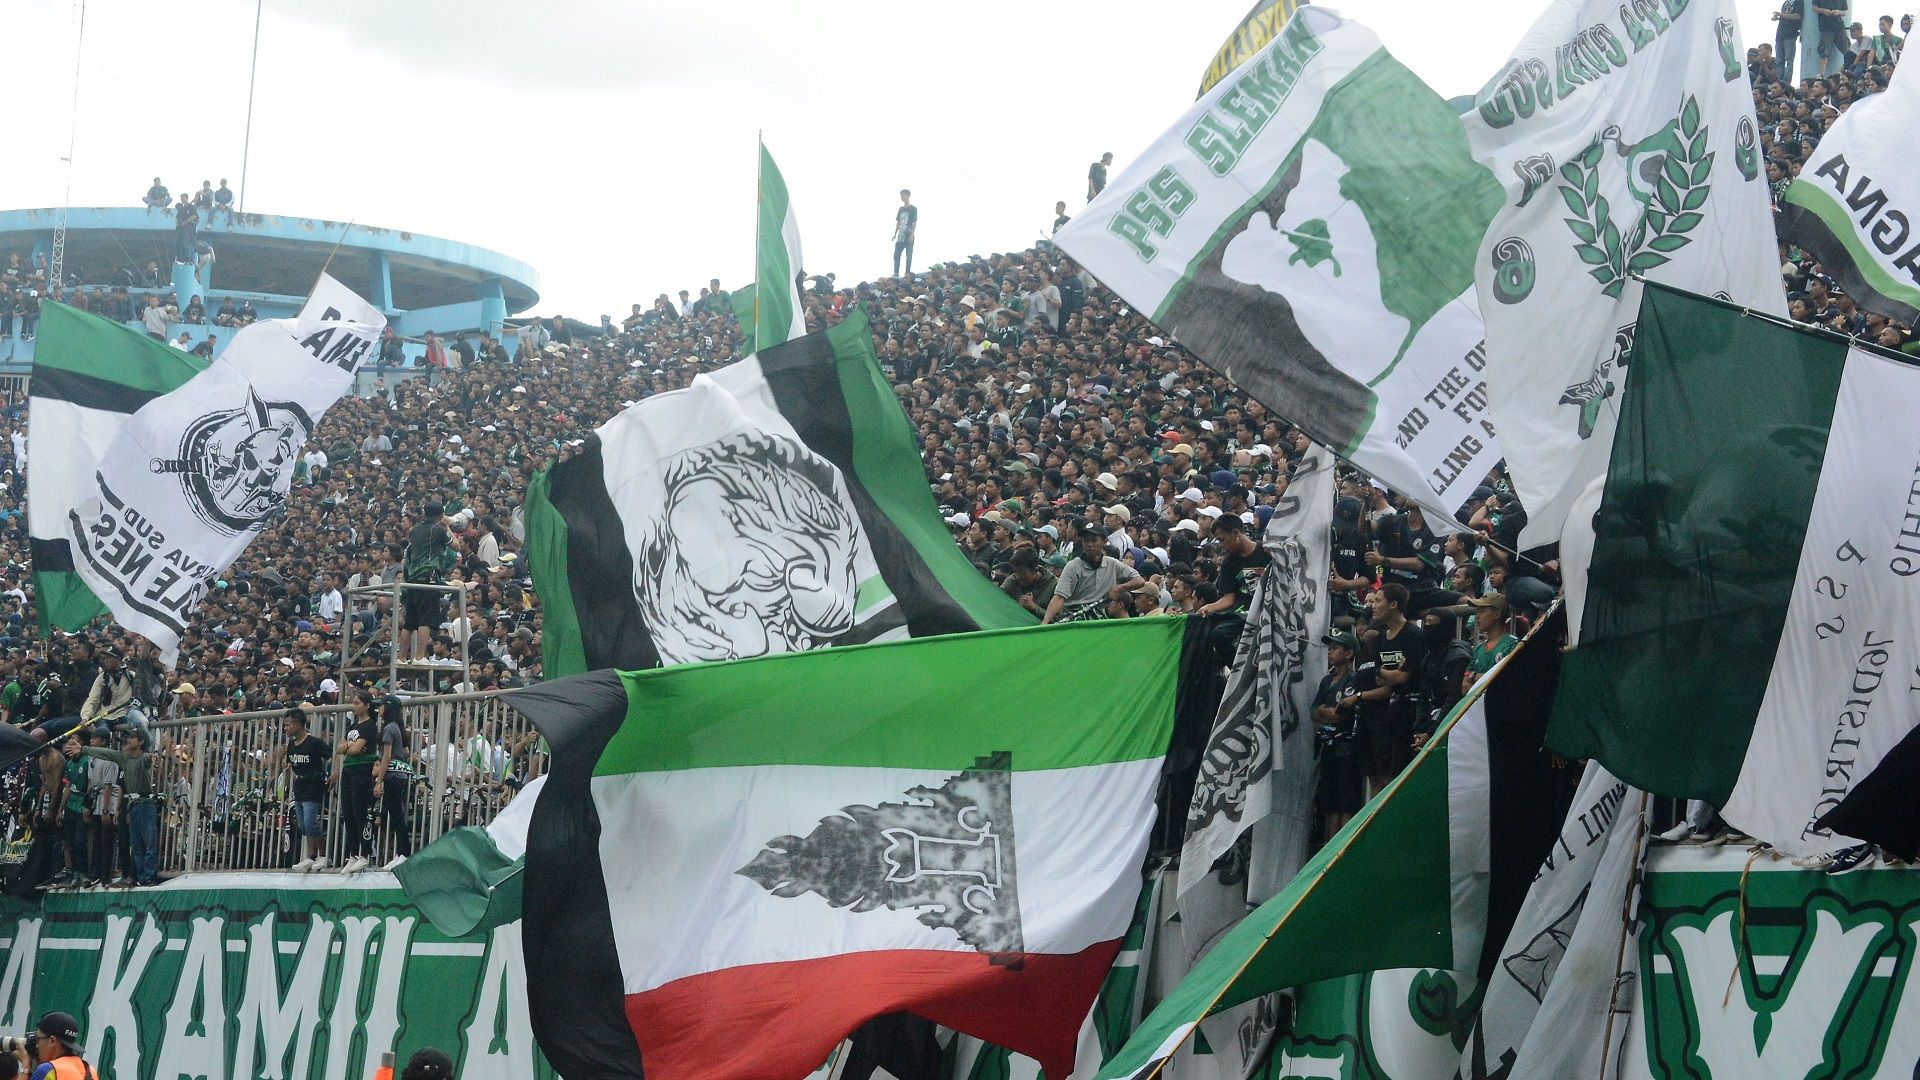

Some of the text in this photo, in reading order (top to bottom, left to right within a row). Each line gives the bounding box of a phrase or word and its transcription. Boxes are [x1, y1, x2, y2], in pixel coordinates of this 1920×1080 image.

[1108, 8, 1326, 264] PSS SLEMAN
[1424, 366, 1470, 410] THE
